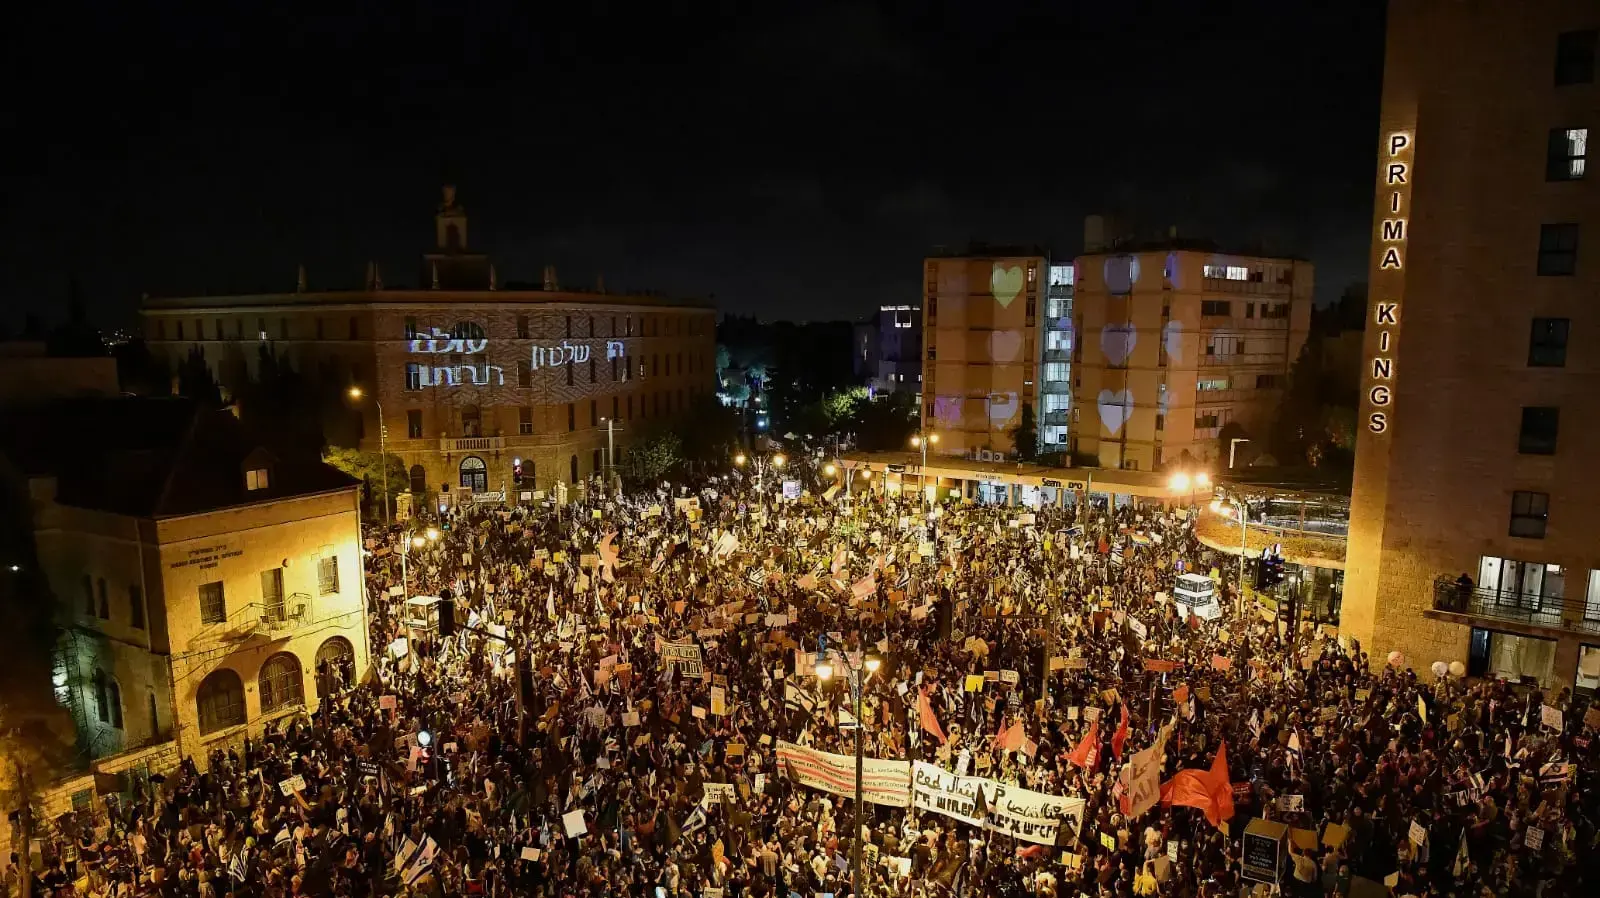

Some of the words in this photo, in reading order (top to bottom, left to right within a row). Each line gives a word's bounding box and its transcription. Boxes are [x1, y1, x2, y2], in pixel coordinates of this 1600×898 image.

[1381, 135, 1407, 269] PRIMA
[532, 340, 590, 370] שלטון
[1369, 304, 1396, 432] KINGS
